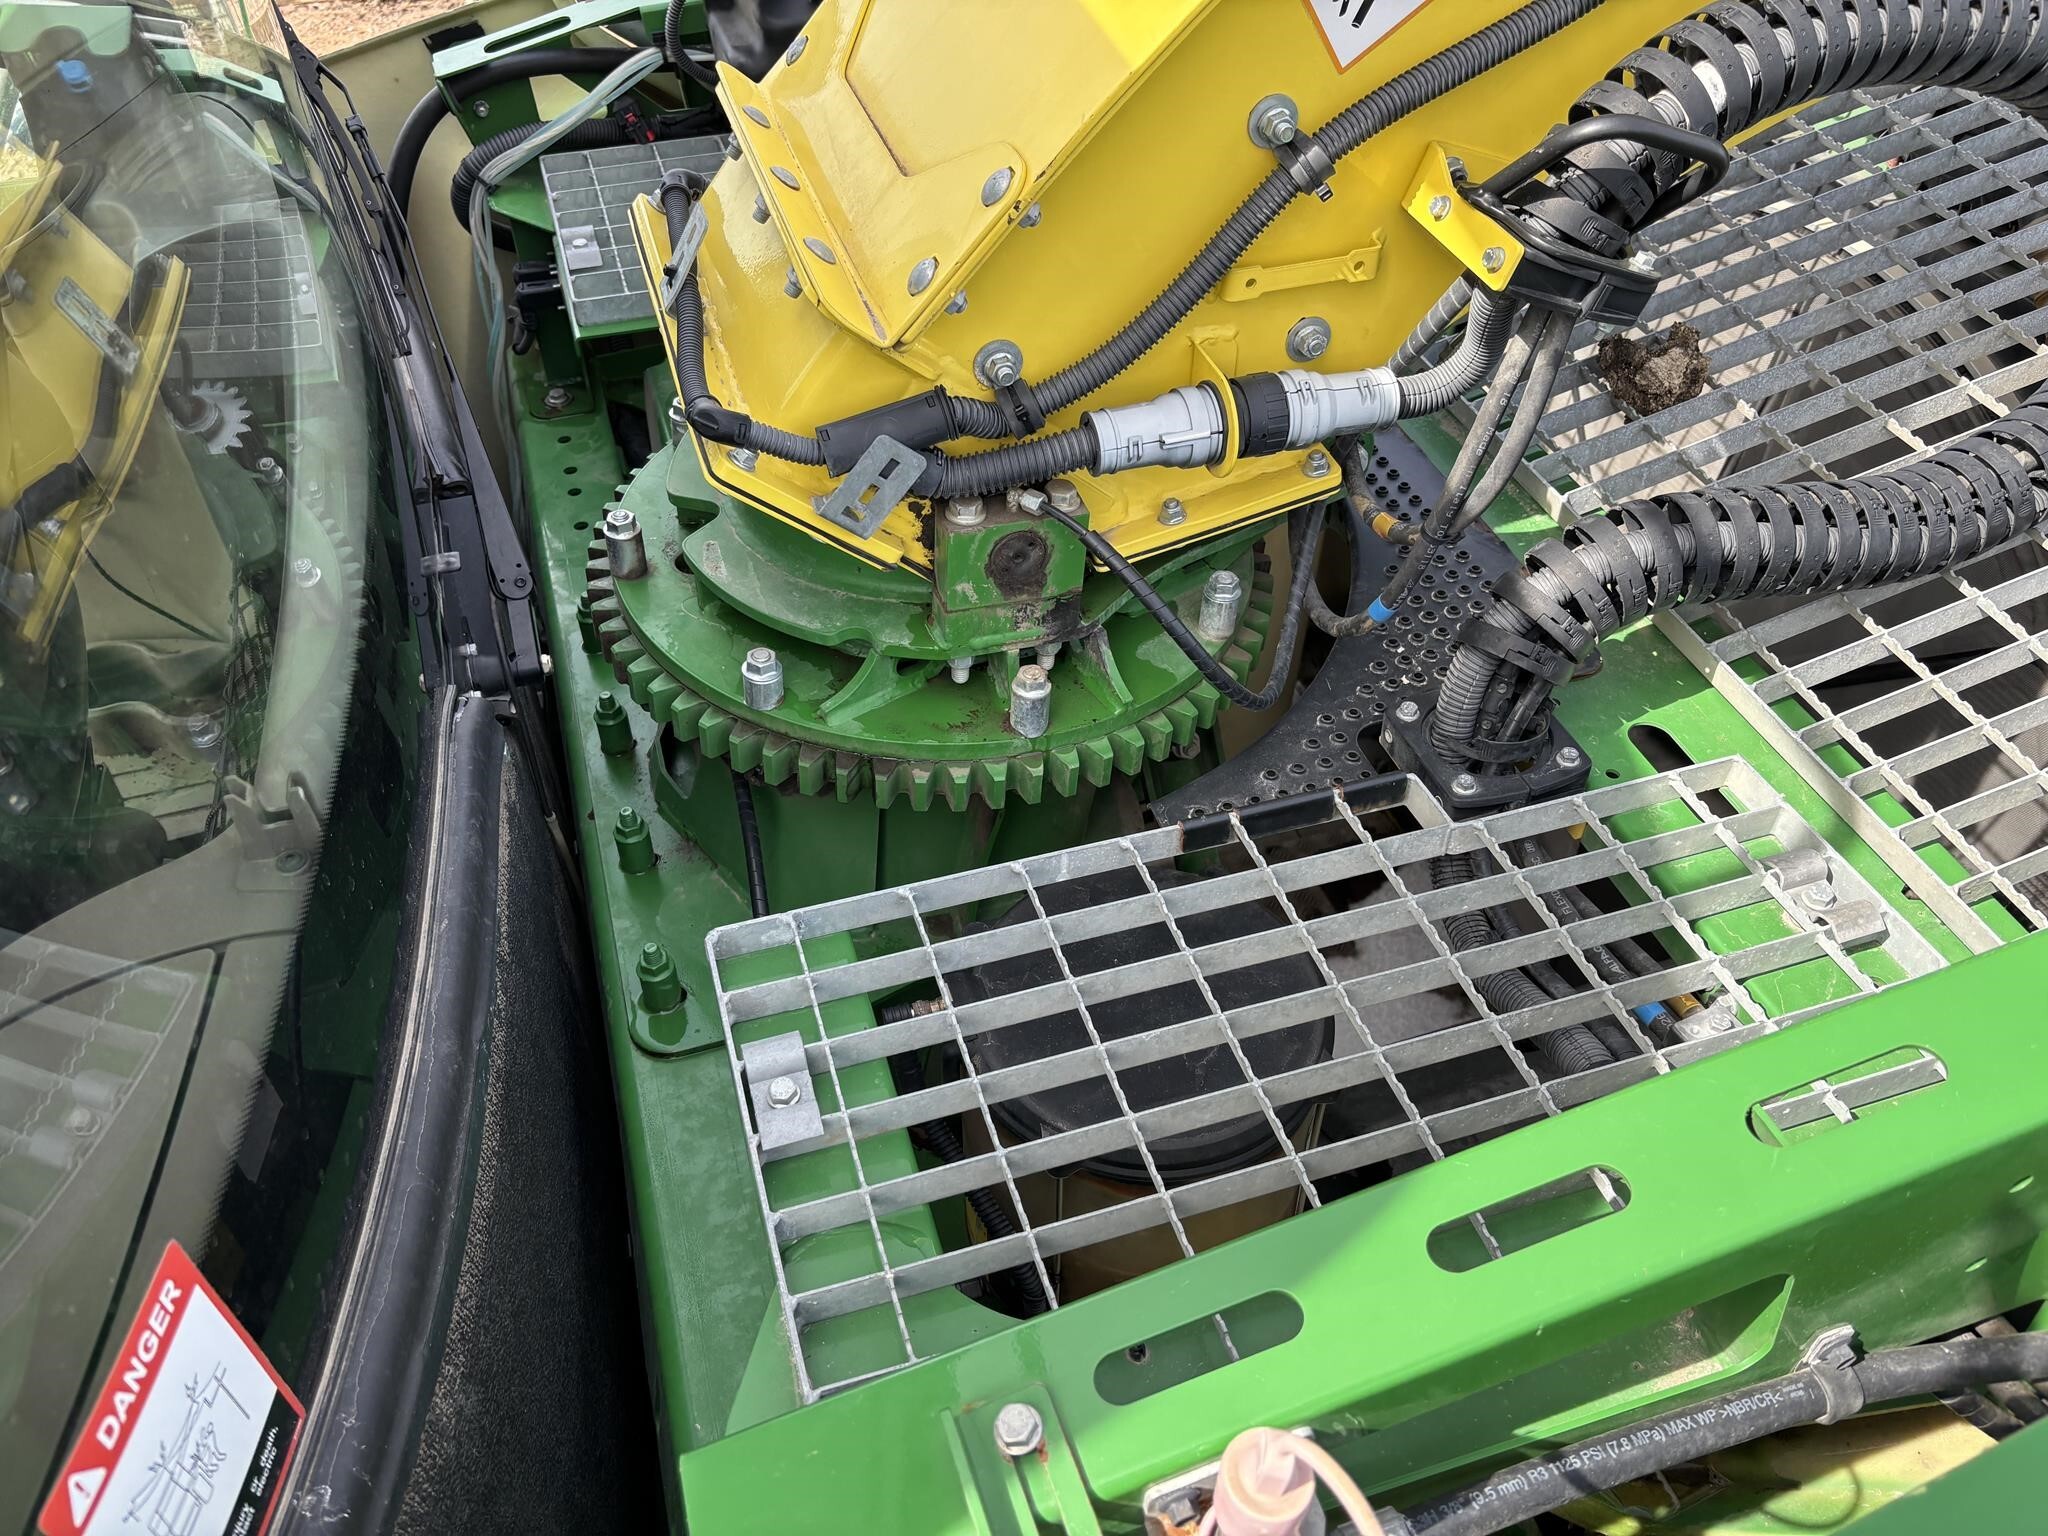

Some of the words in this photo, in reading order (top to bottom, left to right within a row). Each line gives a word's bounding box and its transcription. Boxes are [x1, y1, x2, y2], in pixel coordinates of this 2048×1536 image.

[1476, 426, 1496, 457] Made
[1446, 485, 1467, 518] Italy
[97, 1278, 183, 1450] DANGER
[260, 1426, 279, 1467] death,
[1469, 1485, 1497, 1510] (9.5
[1498, 1474, 1529, 1496] mm)
[1526, 1467, 1549, 1485] R3
[1549, 1454, 1581, 1475] 1125
[1580, 1444, 1608, 1467] PSI
[1606, 1437, 1632, 1459] (7.8
[1632, 1427, 1666, 1448] MPa)
[1665, 1416, 1697, 1437] MAX
[1695, 1408, 1717, 1426] WP
[255, 1446, 277, 1496] electric
